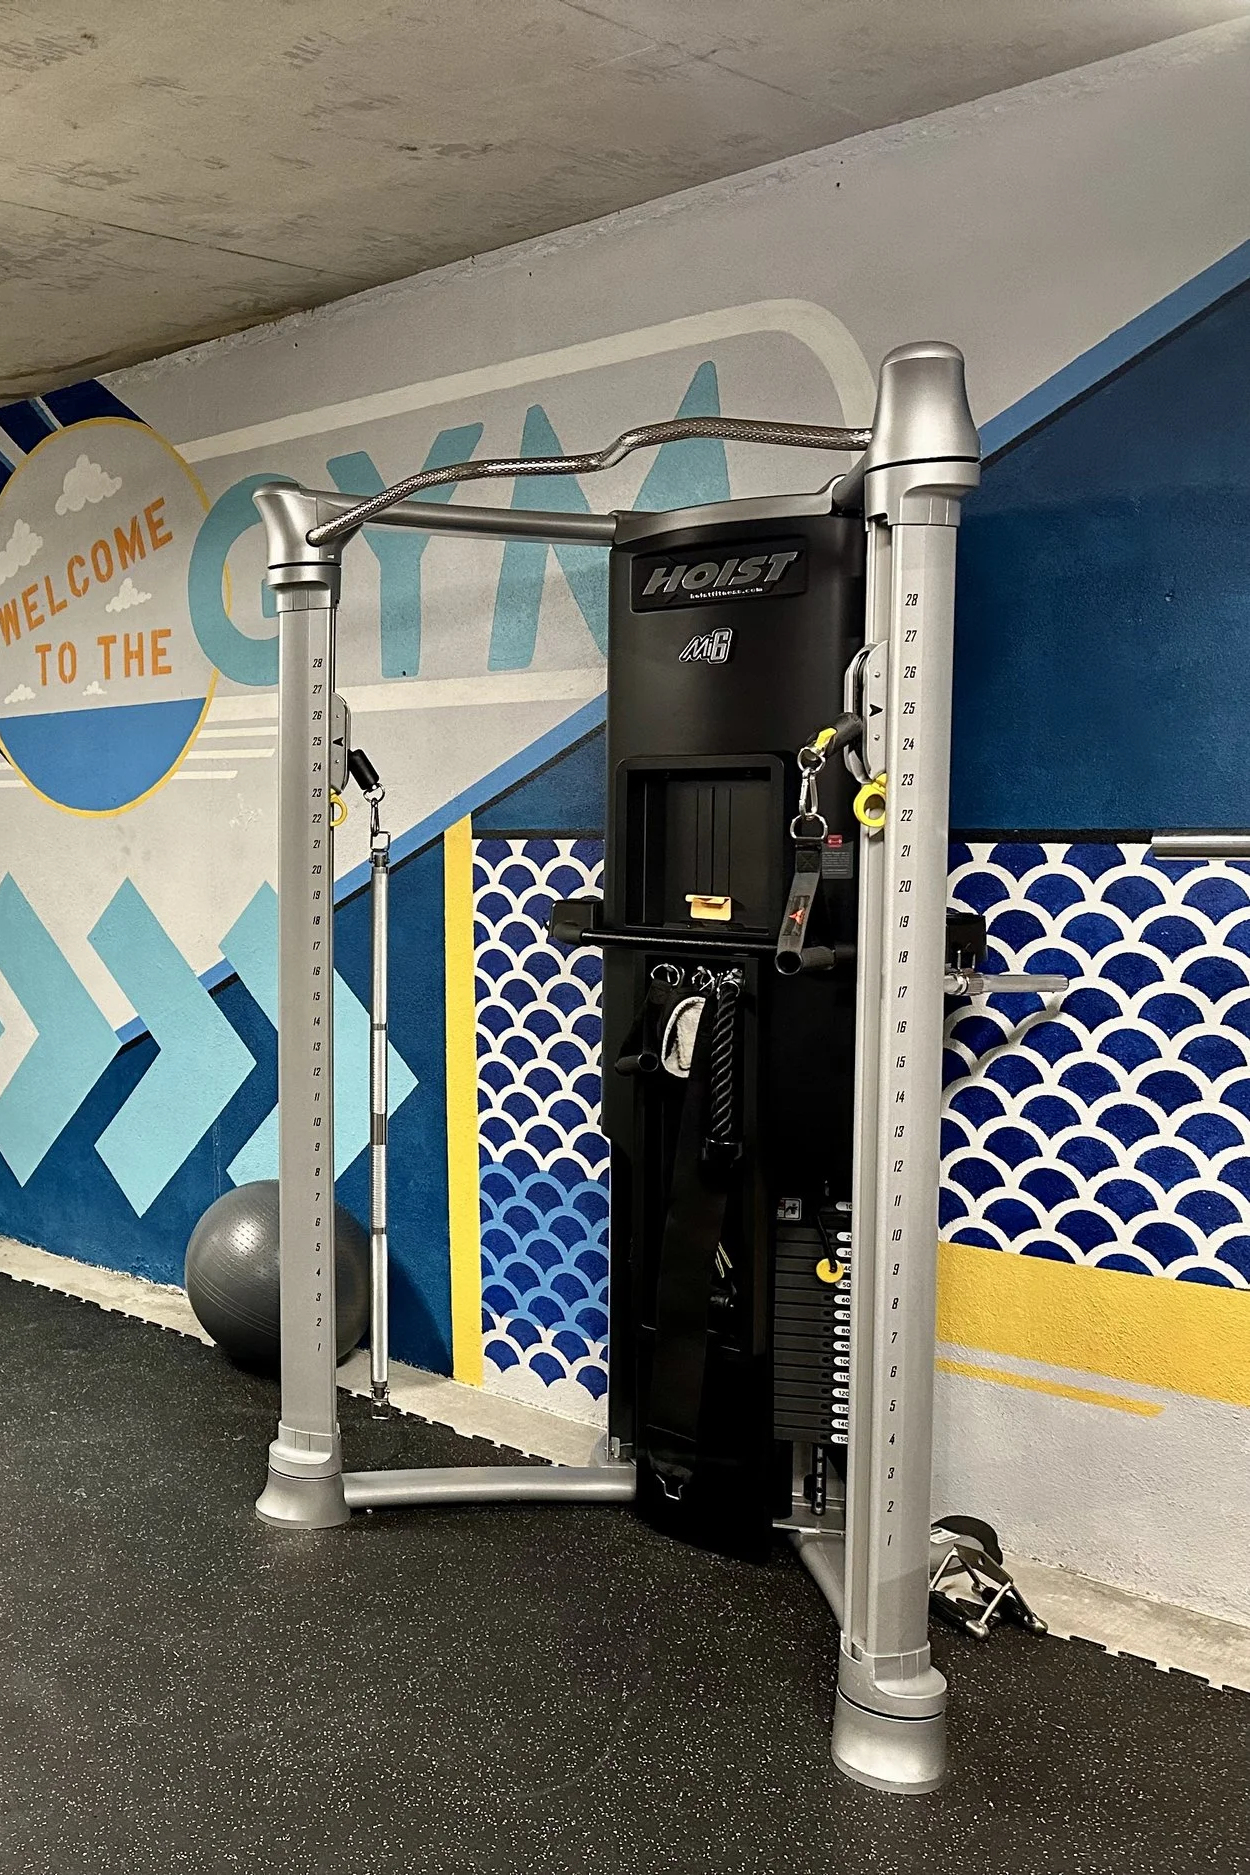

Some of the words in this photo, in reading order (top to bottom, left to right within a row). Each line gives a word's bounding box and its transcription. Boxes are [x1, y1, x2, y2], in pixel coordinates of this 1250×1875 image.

[188, 360, 732, 686] GYM
[642, 552, 798, 595] HOIST
[905, 594, 919, 606] 28
[905, 630, 918, 642] 27
[679, 628, 733, 664] Mi6
[35, 641, 77, 686] TO
[97, 629, 172, 680] THE
[312, 659, 323, 668] 28
[904, 666, 917, 678] 26
[312, 685, 322, 694] 27
[903, 702, 916, 714] 25
[312, 711, 322, 720] 26
[312, 737, 323, 746] 25
[903, 738, 915, 750] 24
[313, 762, 322, 772] 24
[901, 774, 915, 786] 23
[312, 788, 323, 797] 23
[312, 814, 323, 823] 22
[900, 810, 914, 821] 22
[313, 840, 321, 848] 21
[901, 845, 912, 857] 21
[312, 865, 322, 874] 20
[899, 880, 912, 892] 20
[313, 891, 321, 899] 19
[313, 916, 321, 925] 18
[899, 916, 910, 927] 19
[313, 941, 321, 950] 17
[899, 951, 909, 963] 18
[313, 967, 321, 975] 16
[313, 992, 321, 1000] 15
[898, 986, 908, 998] 17
[313, 1017, 321, 1026] 14
[897, 1021, 908, 1033] 16
[313, 1042, 322, 1051] 13
[896, 1056, 907, 1068] 15
[313, 1067, 322, 1076] 12
[314, 1093, 321, 1101] 11
[896, 1091, 906, 1103] 14
[313, 1117, 322, 1126] 10
[894, 1126, 905, 1137] 13
[315, 1143, 321, 1151] 9
[894, 1160, 904, 1172] 12
[315, 1168, 321, 1176] 8
[315, 1193, 321, 1201] 7
[894, 1195, 902, 1206] 11
[315, 1218, 322, 1226] 6
[892, 1229, 903, 1241] 10
[316, 1243, 322, 1251] 5
[316, 1268, 321, 1276] 4
[893, 1264, 900, 1275] 9
[316, 1293, 322, 1301] 3
[892, 1298, 900, 1309] 8
[316, 1318, 322, 1326] 2
[891, 1332, 899, 1343] 7
[890, 1366, 898, 1377] 6
[890, 1400, 897, 1411] 5
[889, 1434, 896, 1445] 4
[888, 1467, 895, 1479] 3
[887, 1501, 895, 1512] 2
